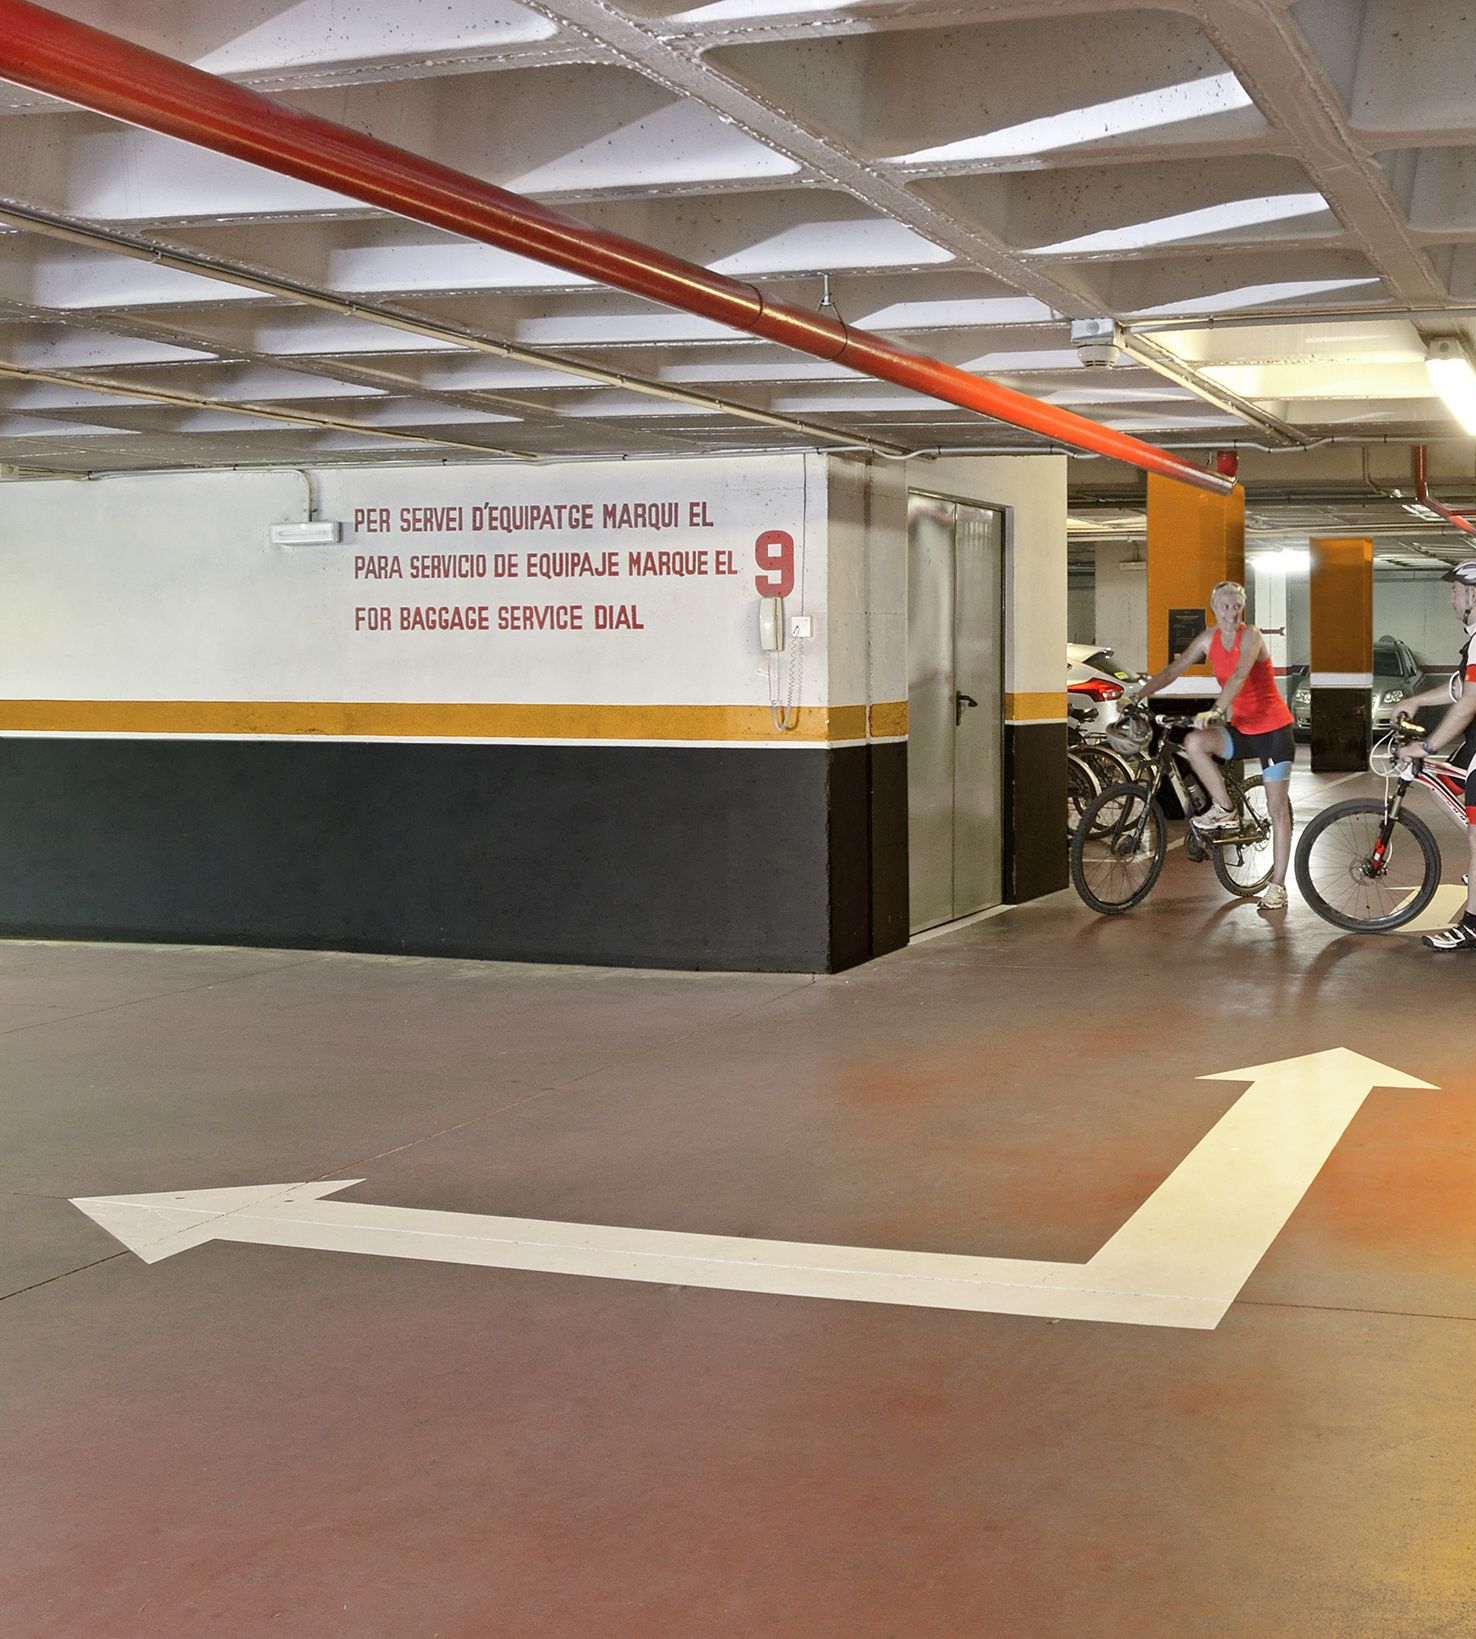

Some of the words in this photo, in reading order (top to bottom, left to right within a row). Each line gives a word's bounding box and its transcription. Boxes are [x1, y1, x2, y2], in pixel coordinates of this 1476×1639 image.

[354, 507, 391, 533] PER
[399, 506, 464, 533] SERVEI
[602, 502, 679, 531] MARQUI
[688, 500, 714, 528] EL
[354, 554, 403, 580] PARA
[409, 553, 487, 580] SERVICIO
[493, 553, 519, 579] DE
[526, 550, 620, 578] EQUIPAJE
[627, 549, 709, 578] MARQUE
[714, 548, 738, 576] EL
[754, 529, 796, 599] 9
[354, 606, 393, 632] FOR
[399, 605, 490, 632] BAGGAGE
[497, 603, 584, 631] SERVICE
[594, 603, 645, 631] DIAL
